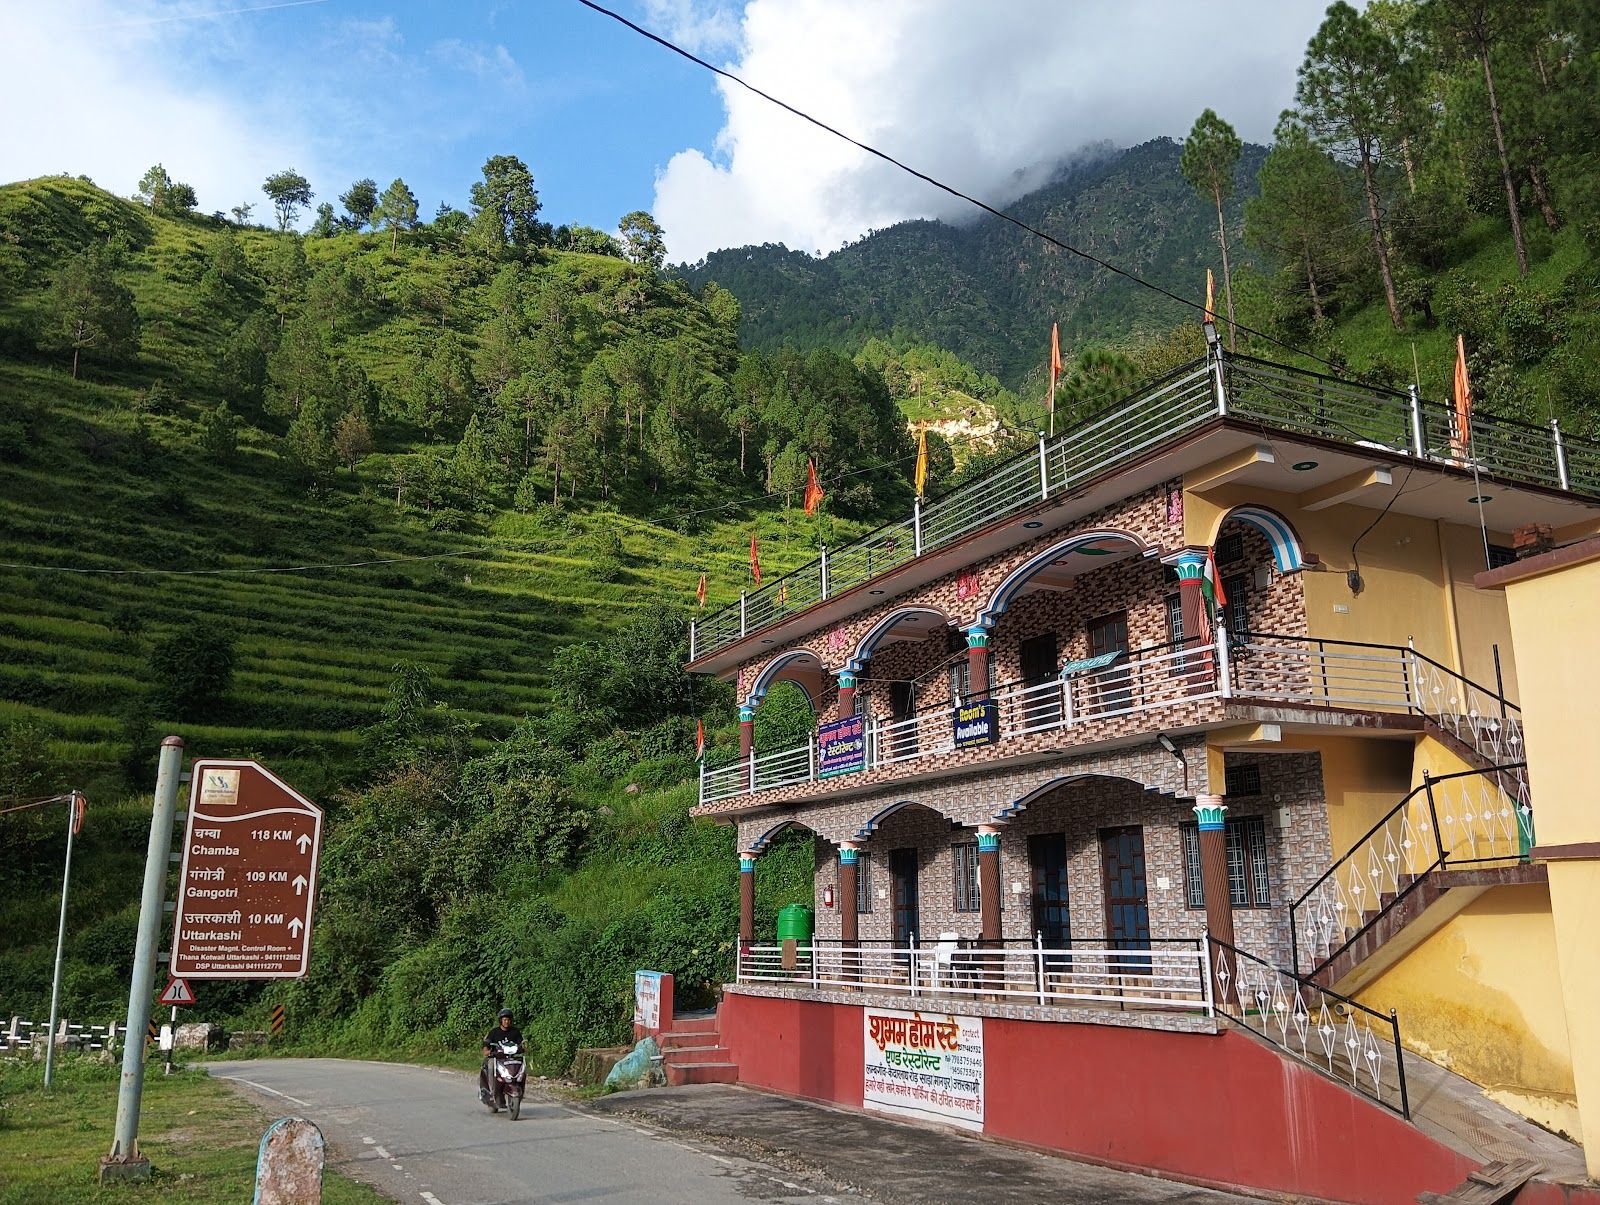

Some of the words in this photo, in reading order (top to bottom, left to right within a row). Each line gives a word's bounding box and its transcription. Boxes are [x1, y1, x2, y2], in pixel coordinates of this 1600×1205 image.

[960, 704, 986, 722] Room's
[957, 721, 989, 740] Available
[251, 830, 270, 841] 118
[273, 830, 292, 841] KM
[191, 845, 240, 856] Chamba
[189, 866, 225, 881] गंगोत्री
[246, 872, 265, 882] 109
[268, 871, 288, 882] KM
[186, 887, 239, 899] Gangotri
[184, 909, 242, 924] उत्तरकाशी
[248, 914, 261, 924] 10
[264, 914, 284, 924] KM
[181, 930, 242, 941] Uttarkashi
[868, 1014, 908, 1051] शुभम
[909, 1011, 936, 1049] होम
[885, 1049, 902, 1066] एण्ड
[902, 1046, 941, 1071] रेस्टोरेन्ट
